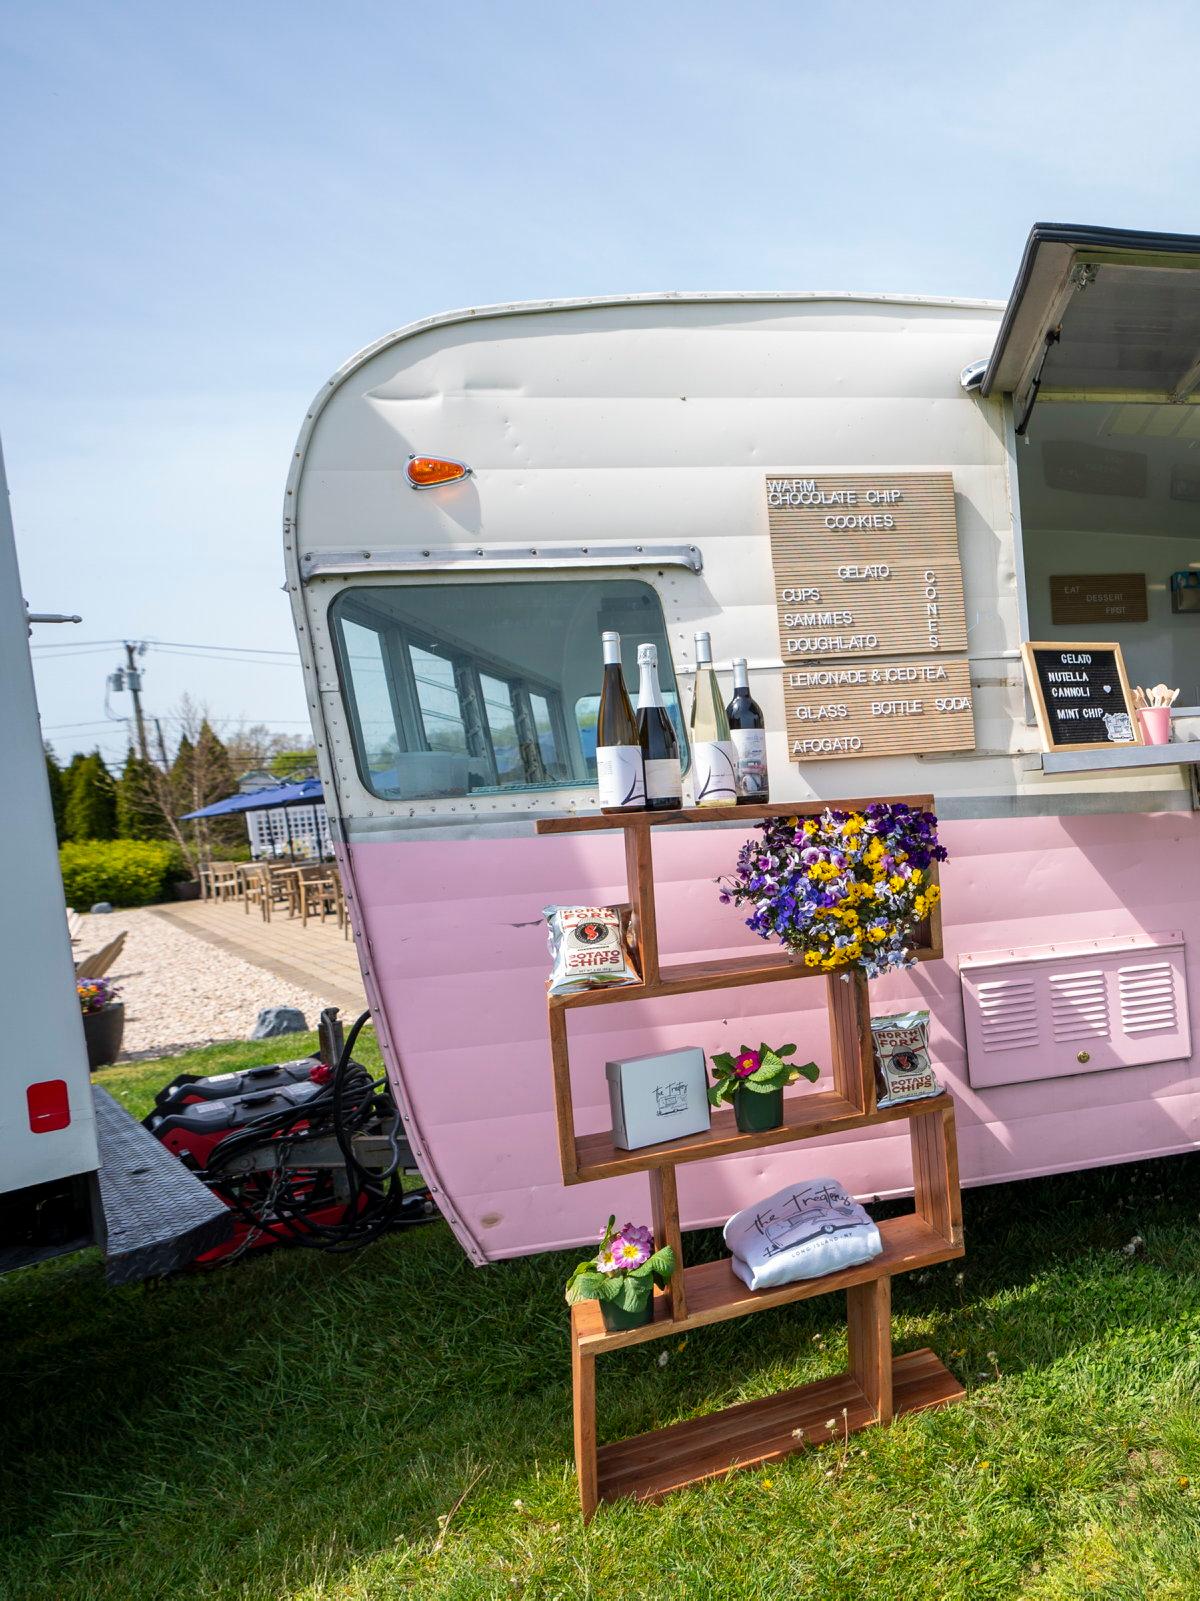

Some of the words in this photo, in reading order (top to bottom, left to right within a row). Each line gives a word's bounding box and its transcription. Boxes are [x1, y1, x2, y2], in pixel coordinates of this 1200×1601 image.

[767, 480, 816, 492] WARM
[769, 491, 857, 505] CHOCOLATE
[866, 490, 901, 503] CHIP
[825, 514, 894, 529] COOKIES
[838, 565, 889, 578] GELATO
[782, 588, 820, 602] CUPS
[1086, 593, 1124, 602] DESSERT
[925, 570, 939, 648] CONES
[1105, 606, 1127, 614] FIRST
[784, 612, 853, 627] SAMMIES
[787, 635, 877, 652] DOUGHLATO
[1061, 654, 1092, 665] GELATO
[789, 670, 867, 686] LEMONADE
[871, 669, 881, 682] &
[886, 668, 916, 681] ICED
[920, 666, 947, 679] TEA
[1048, 672, 1089, 683] NUTELLA
[1052, 688, 1091, 698] CANNOLI
[797, 704, 847, 720] GLASS
[872, 700, 922, 715] BOTTLE
[935, 697, 971, 711] SODA
[1057, 709, 1080, 720] MINT
[1083, 708, 1104, 719] CHIP
[792, 736, 861, 753] AFOGATO
[563, 912, 616, 920] FORK
[568, 956, 620, 967] CHIPS
[877, 1029, 918, 1039] NORTH
[880, 1037, 919, 1048] FORK
[890, 1075, 932, 1088] POTATO
[892, 1081, 932, 1094] CHIPS
[744, 1209, 776, 1235] The
[813, 1236, 839, 1249] ISLAND
